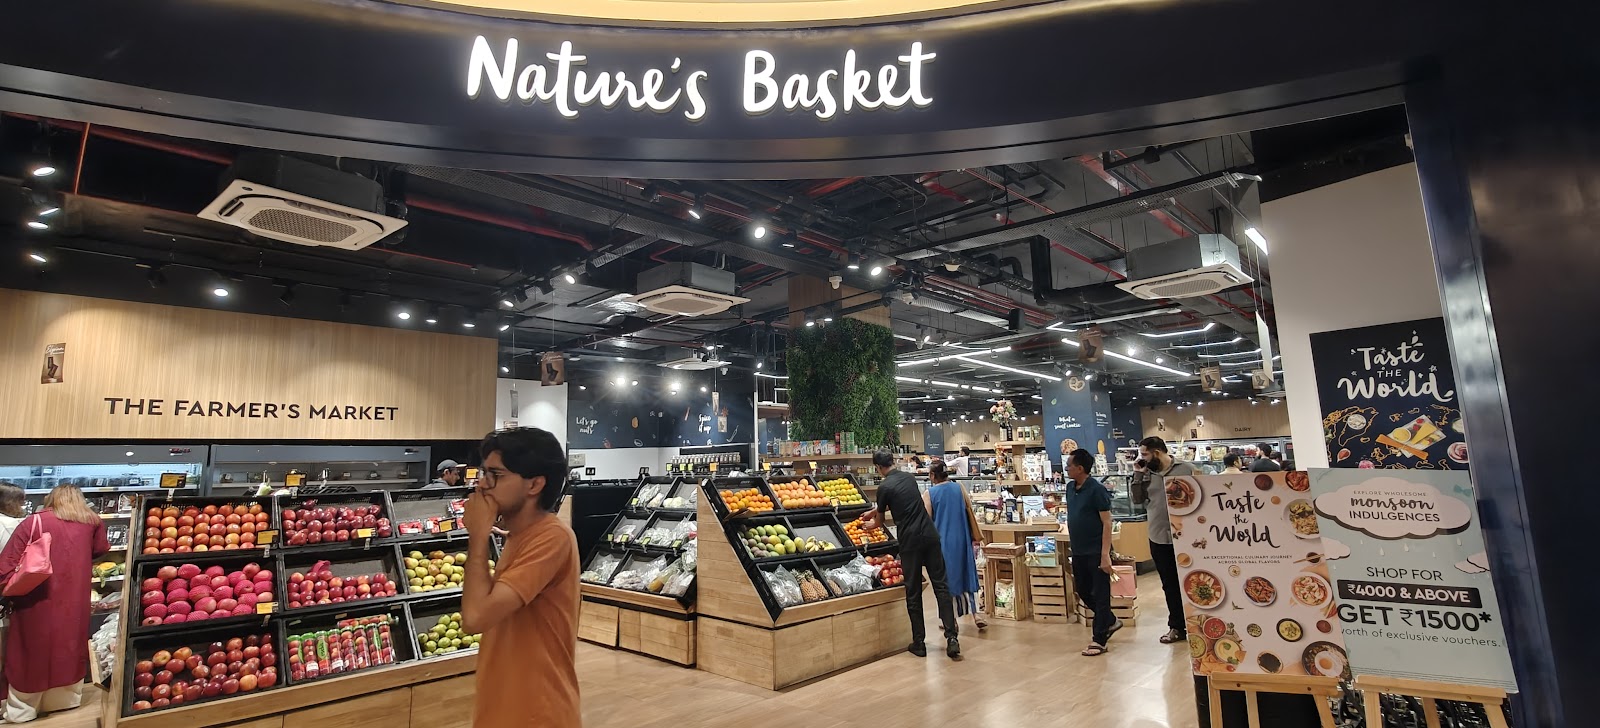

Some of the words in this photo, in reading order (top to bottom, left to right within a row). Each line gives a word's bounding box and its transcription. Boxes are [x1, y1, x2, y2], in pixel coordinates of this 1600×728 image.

[467, 35, 708, 120] Nature's
[743, 41, 937, 119] Basket
[1357, 342, 1425, 370] Taste
[1377, 369, 1402, 378] THE
[1337, 370, 1453, 402] World
[104, 397, 164, 415] THE
[174, 400, 300, 419] FARMER'S
[309, 404, 399, 421] MARKET
[1211, 490, 1265, 513] Taste
[1350, 497, 1435, 511] monsoon
[1233, 513, 1249, 525] the
[1349, 511, 1440, 522] INDULGENCES
[1209, 523, 1281, 548] World
[1366, 566, 1408, 580] SHOP
[1412, 569, 1444, 582] FOR
[1347, 583, 1396, 598] ₹4000
[1400, 587, 1412, 600] &
[1414, 588, 1471, 603] ABOVE
[1337, 603, 1394, 626] GET
[1371, 628, 1383, 639] of
[1386, 630, 1439, 643] exclusive
[1442, 635, 1501, 648] vouchers.
